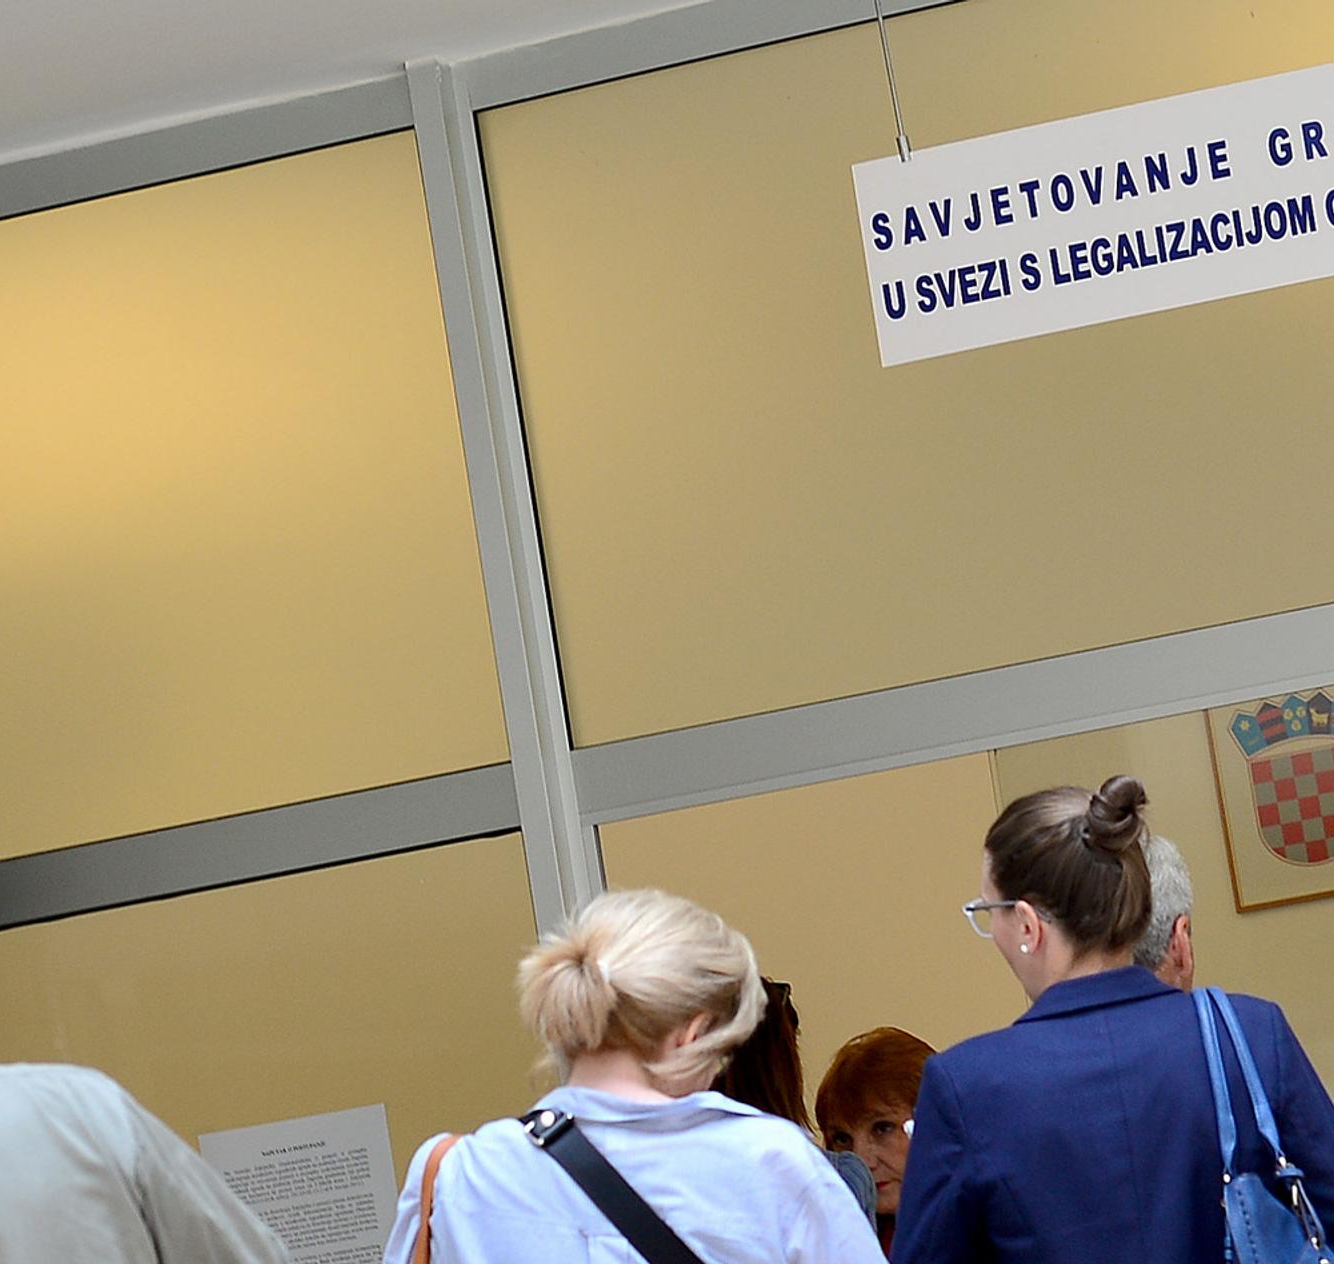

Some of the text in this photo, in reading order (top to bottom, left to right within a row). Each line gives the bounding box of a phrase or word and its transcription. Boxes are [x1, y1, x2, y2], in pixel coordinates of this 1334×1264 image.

[871, 140, 1232, 252] SAVJETOVANJE
[882, 282, 907, 321] U
[916, 259, 1012, 314] SVEZI
[1019, 253, 1042, 291] S
[1049, 194, 1317, 286] LEGALIZACIJOM
